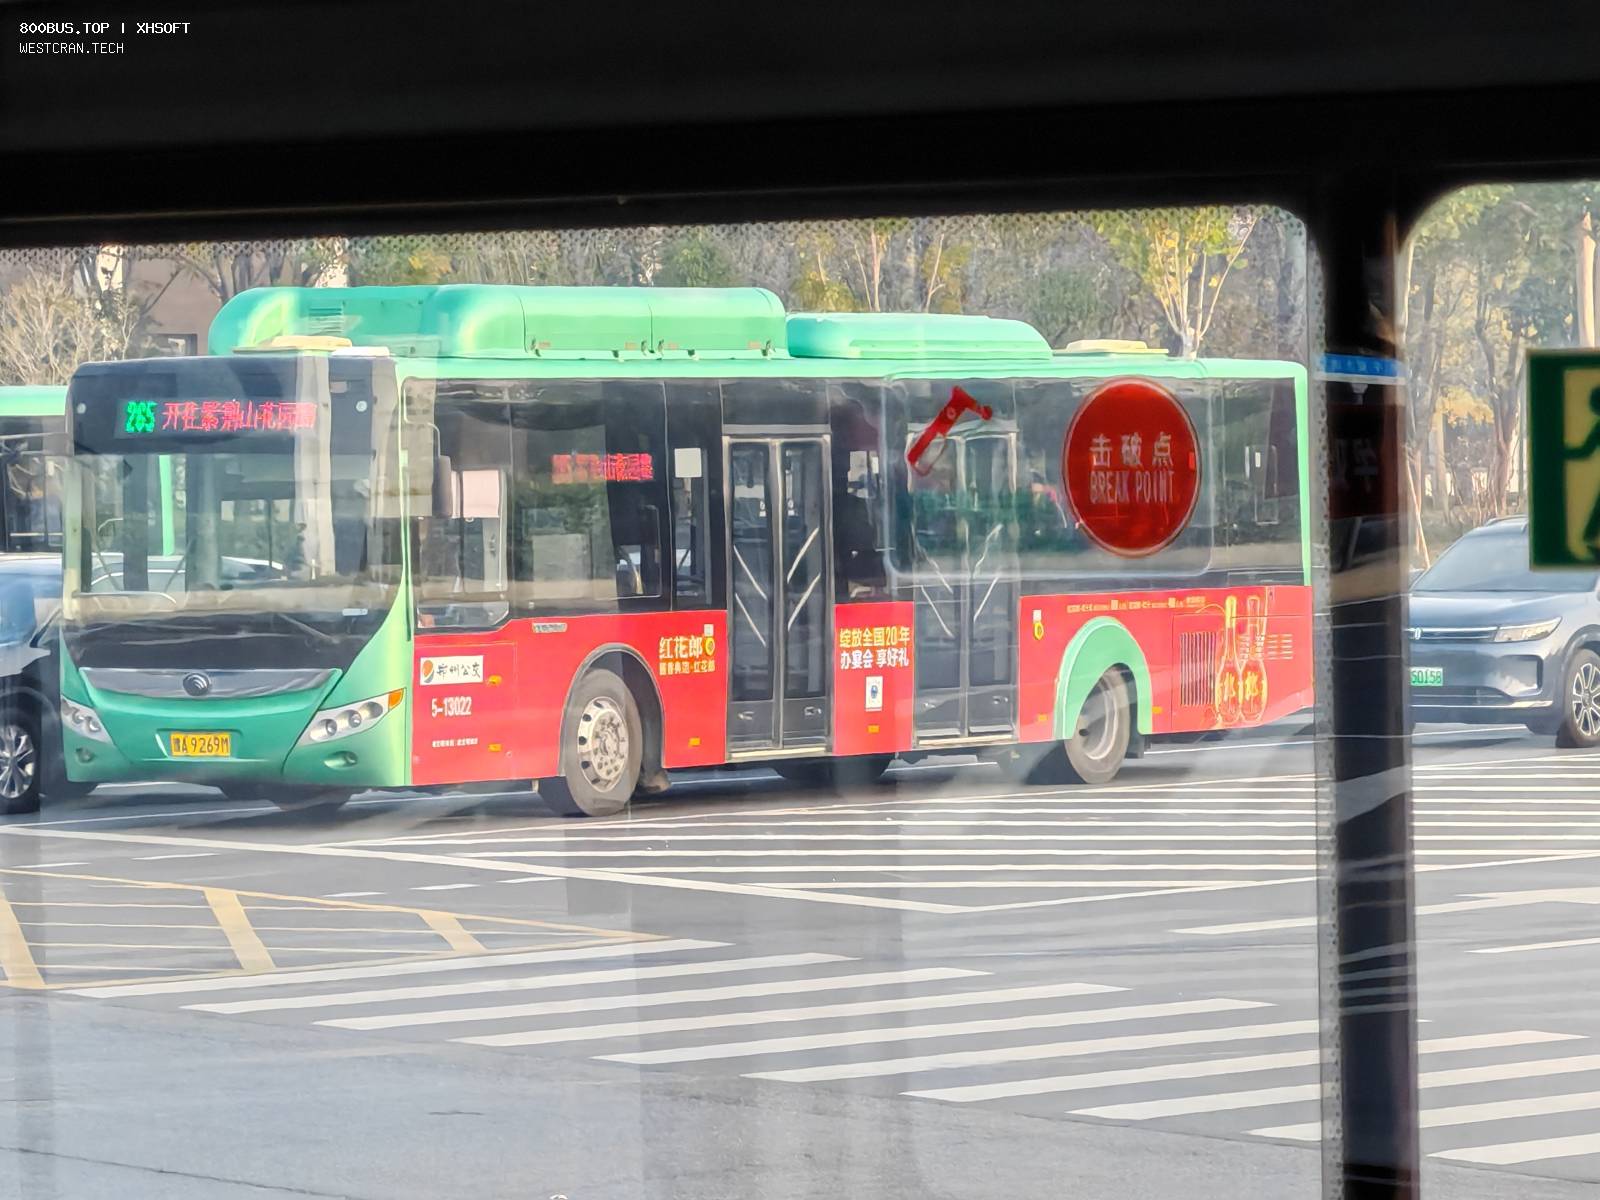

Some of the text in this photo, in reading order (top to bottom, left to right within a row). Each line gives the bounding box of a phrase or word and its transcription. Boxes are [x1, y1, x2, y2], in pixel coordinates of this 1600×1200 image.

[1089, 432, 1174, 467] 击破点
[1090, 470, 1174, 504] BREAK POINT
[659, 635, 703, 658] 红花郎
[840, 647, 909, 670] 办宴会 享好礼
[431, 696, 472, 717] 5-13022
